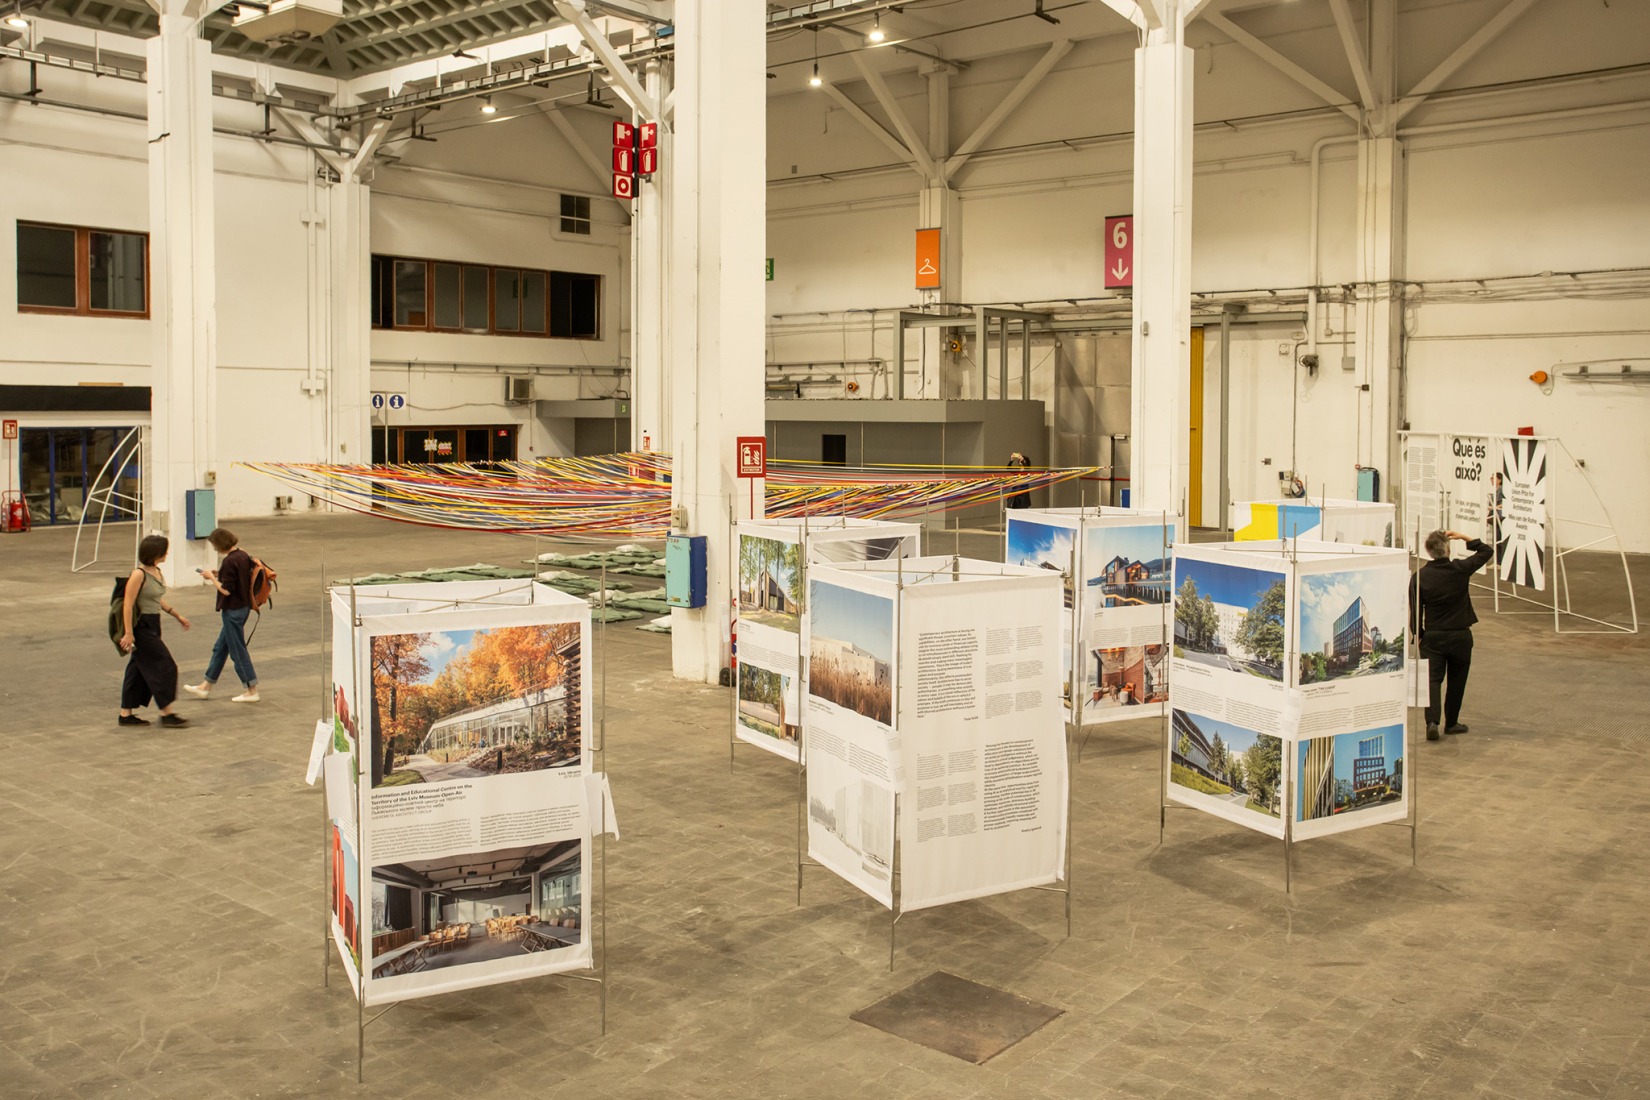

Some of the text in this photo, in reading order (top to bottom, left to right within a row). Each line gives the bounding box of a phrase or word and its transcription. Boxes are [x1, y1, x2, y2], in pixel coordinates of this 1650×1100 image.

[1113, 222, 1127, 248] 6
[1453, 438, 1486, 458] Què és
[1455, 460, 1482, 482] això?
[372, 798, 392, 806] Territory
